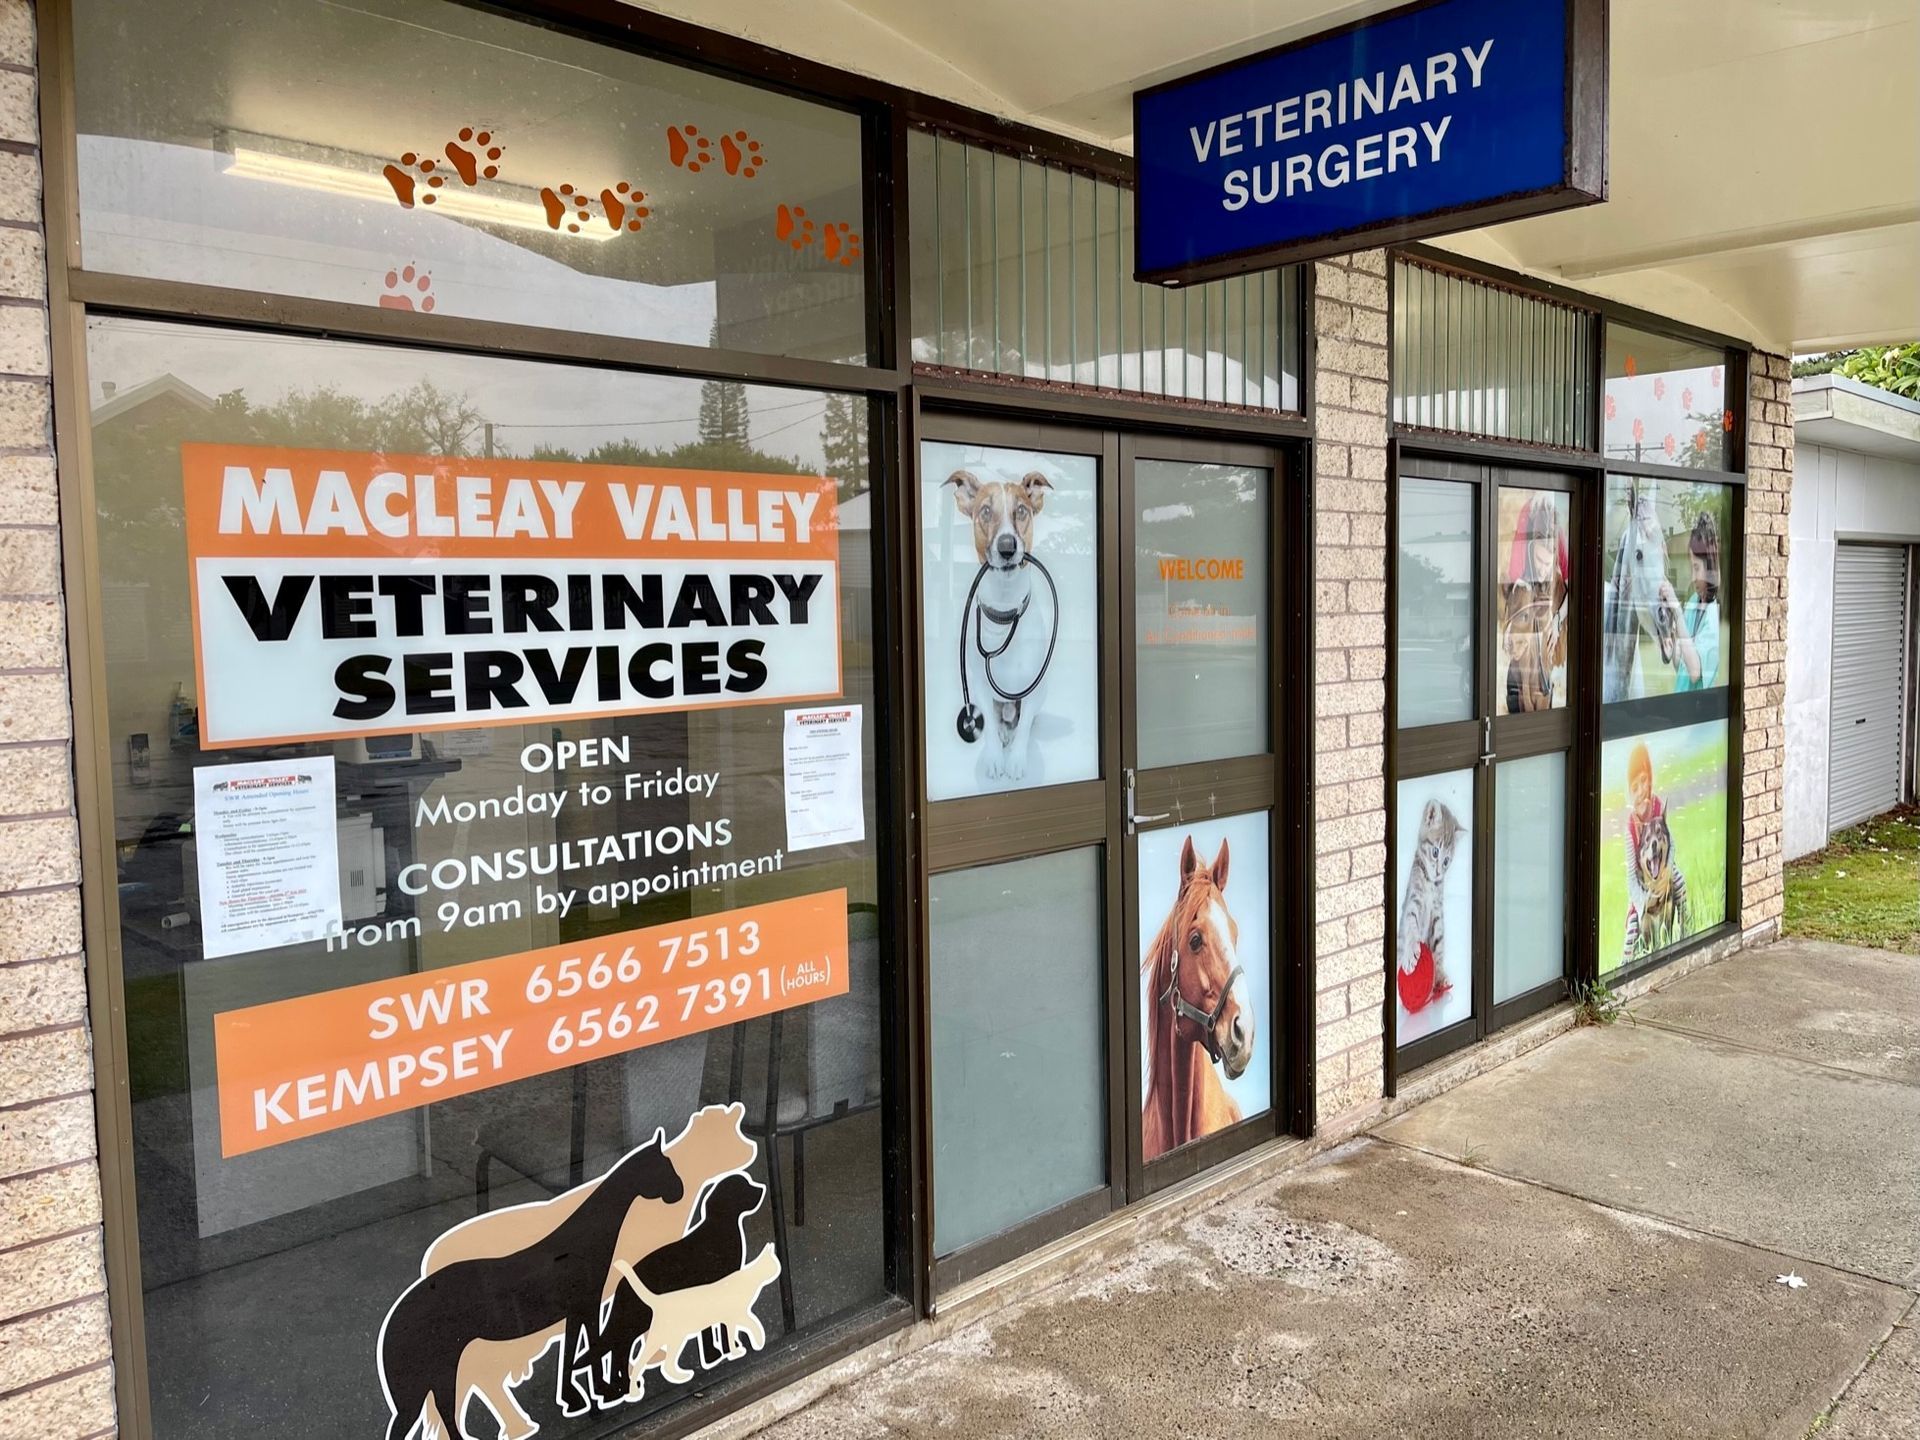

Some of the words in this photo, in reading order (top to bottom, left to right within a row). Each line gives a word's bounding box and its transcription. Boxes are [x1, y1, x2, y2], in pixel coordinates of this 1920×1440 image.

[1189, 39, 1494, 163] VETERINARY
[1222, 116, 1452, 211] SURGERY
[219, 466, 586, 538] MACLEAY
[608, 483, 820, 543] VALLEY
[221, 574, 823, 642] VETERINARY
[1158, 559, 1245, 581] WELCOME
[333, 639, 767, 721] SERVICES
[520, 736, 630, 773] OPEN
[415, 786, 568, 827] Monday
[579, 783, 611, 806] to
[625, 768, 719, 800] Friday
[398, 818, 732, 895] CONSULTATIONS
[323, 914, 421, 952] from
[437, 897, 521, 932] 9am
[537, 885, 576, 918] by
[588, 849, 783, 908] appointment
[367, 978, 490, 1040] SWR
[525, 953, 642, 1003] 6566
[658, 921, 760, 974] 7513
[253, 1028, 514, 1131] KEMPSEY
[547, 995, 660, 1055] 6562
[676, 968, 774, 1023] 7391
